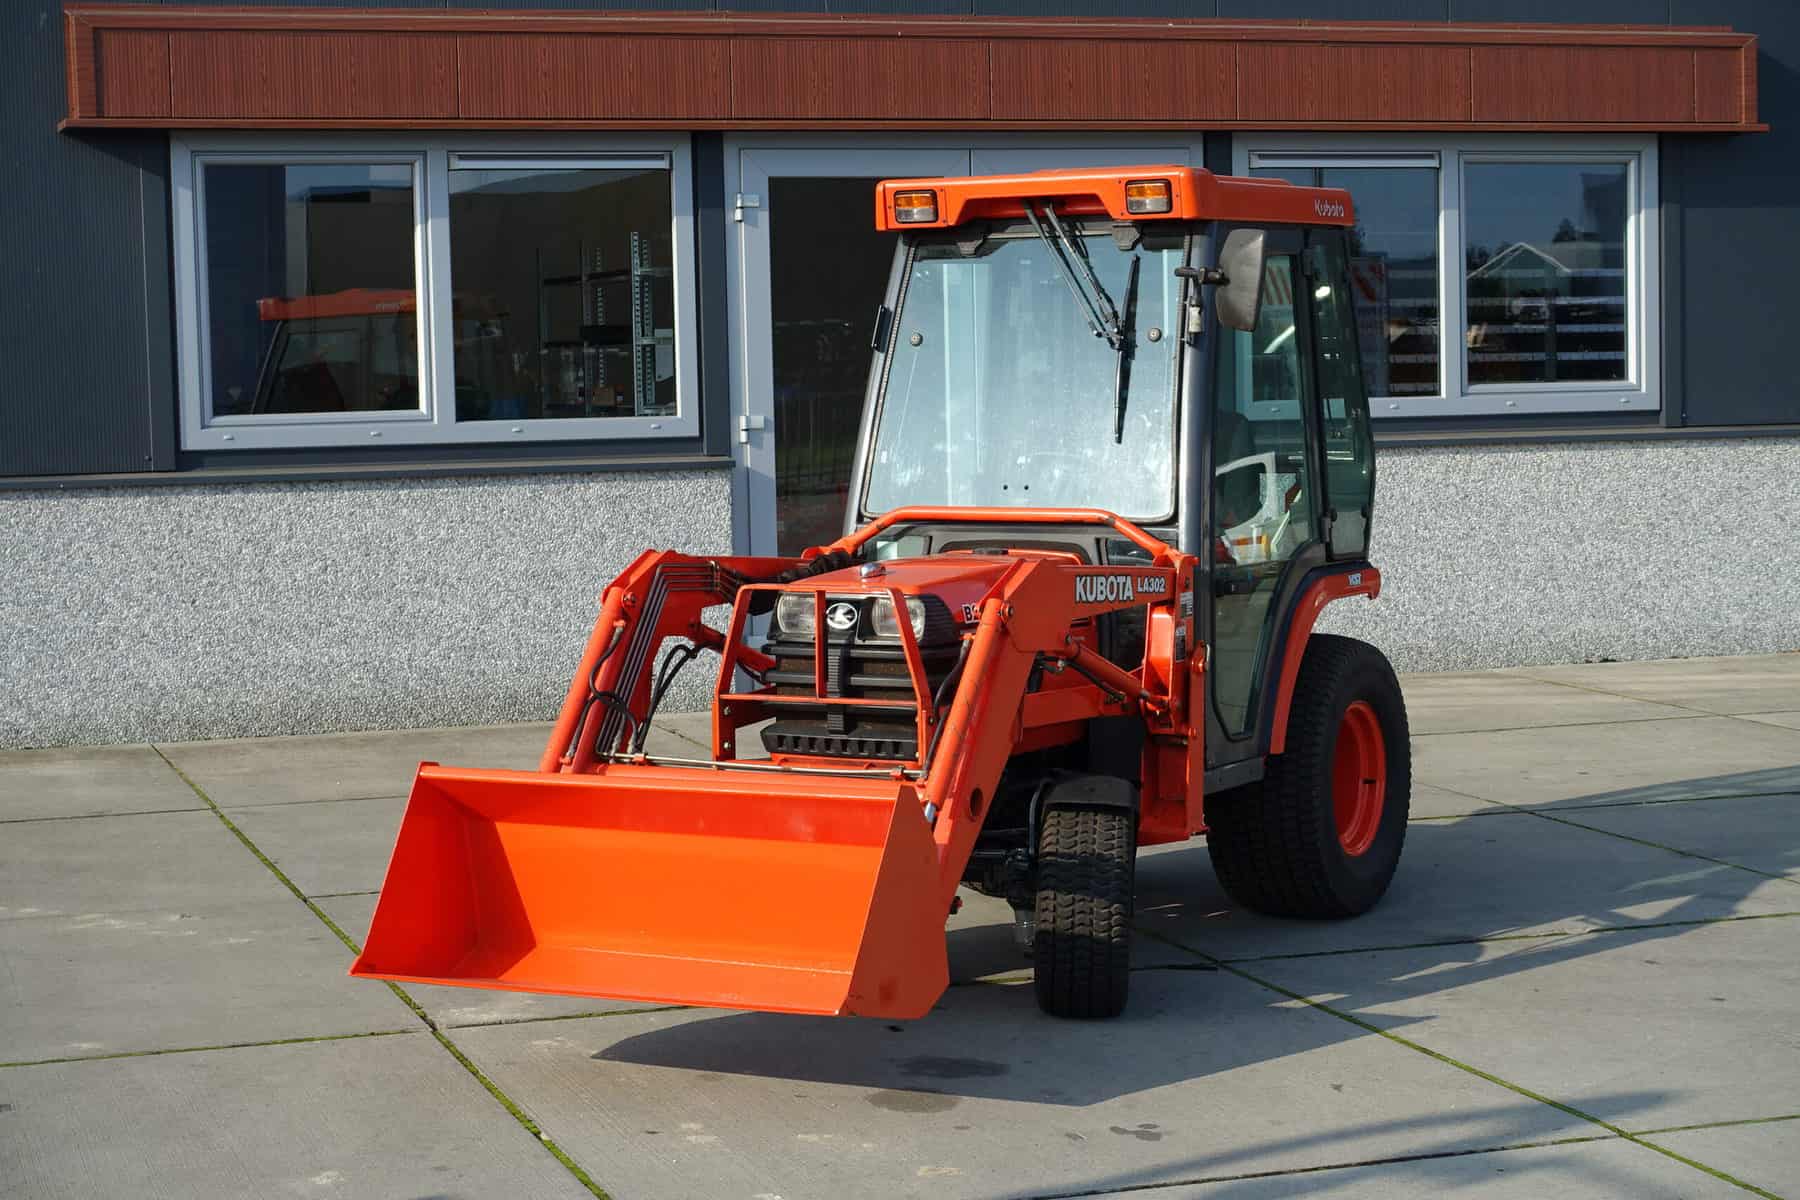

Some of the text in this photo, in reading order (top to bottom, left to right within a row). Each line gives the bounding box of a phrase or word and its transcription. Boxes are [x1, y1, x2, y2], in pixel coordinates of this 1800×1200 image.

[1314, 199, 1344, 217] Kubota
[1074, 575, 1166, 602] KUBOTA LA302
